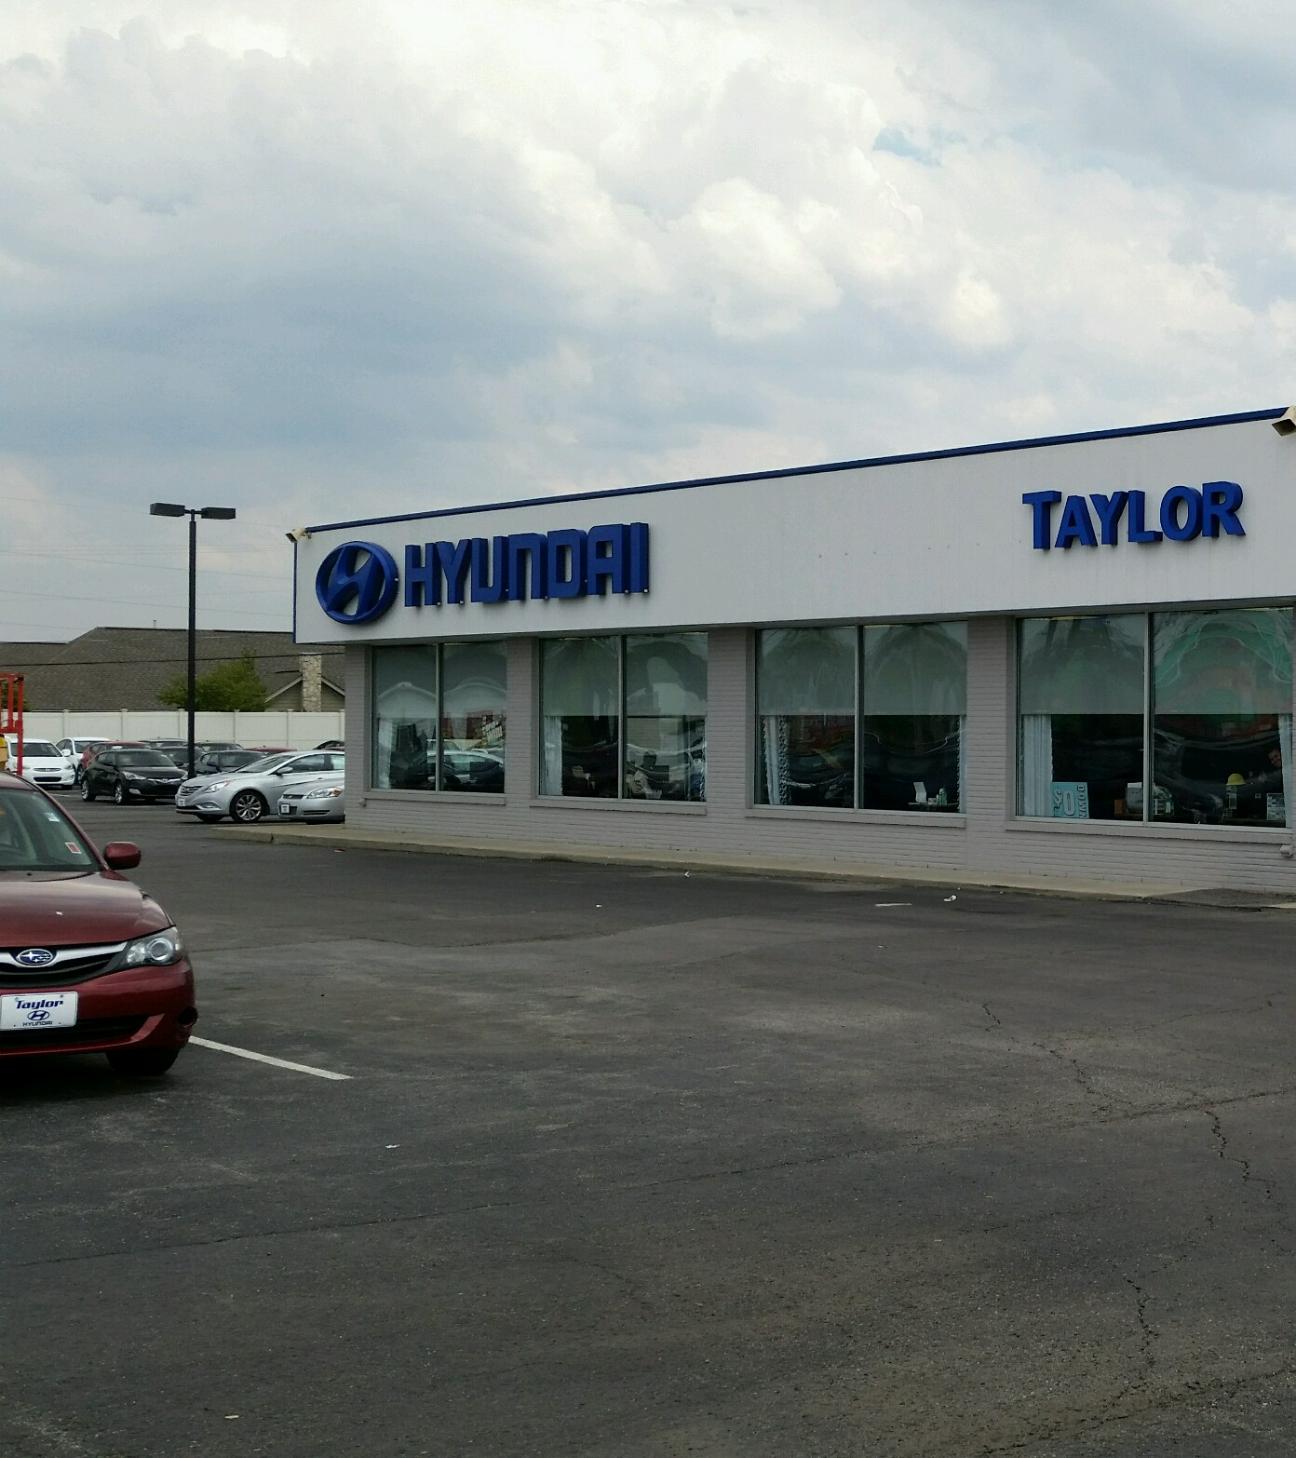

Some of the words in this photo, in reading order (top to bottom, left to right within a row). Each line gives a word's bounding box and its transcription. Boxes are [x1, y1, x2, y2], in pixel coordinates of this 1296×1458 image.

[1022, 481, 1246, 550] TAYLOR
[404, 522, 650, 607] HYUNDAI
[16, 1000, 63, 1010] Taylor
